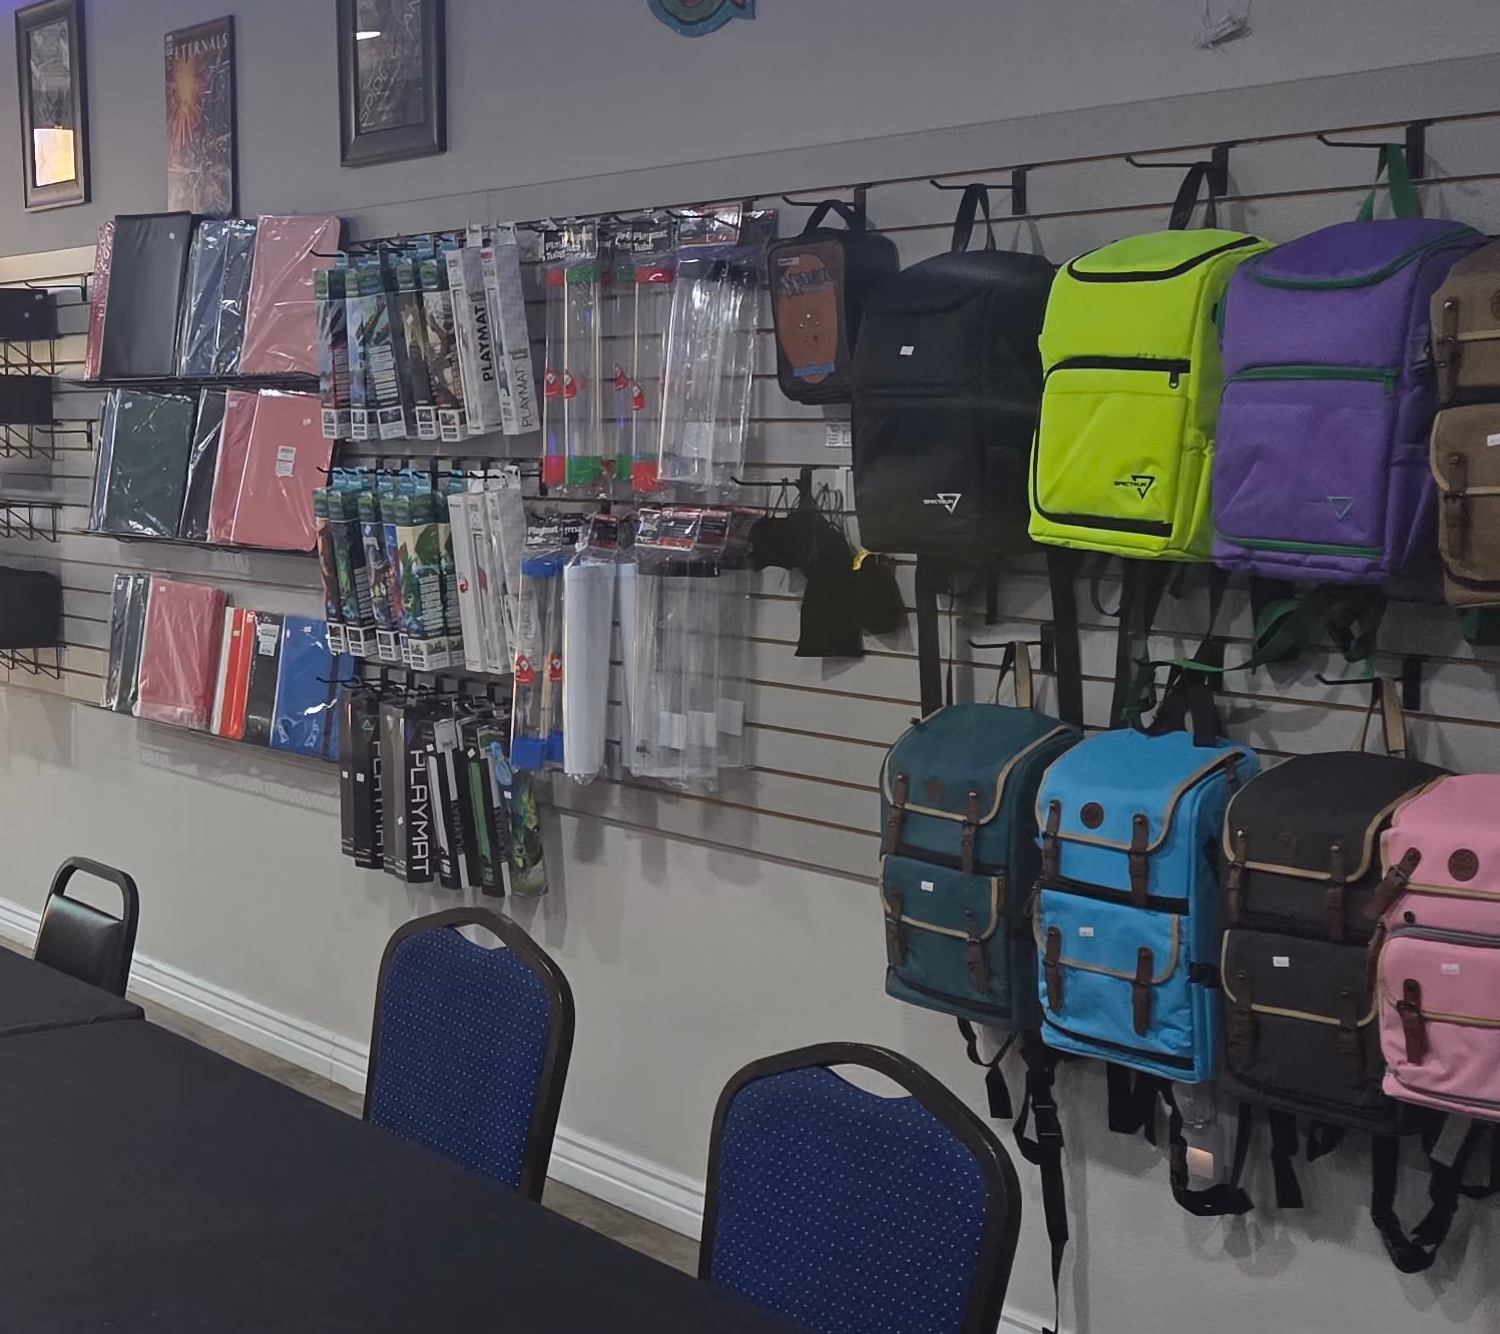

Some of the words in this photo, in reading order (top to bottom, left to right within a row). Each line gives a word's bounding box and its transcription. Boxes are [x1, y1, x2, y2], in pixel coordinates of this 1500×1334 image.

[174, 33, 228, 60] ETERNALS
[474, 305, 494, 382] PLAYMAT
[515, 369, 533, 428] PLAYMAT
[410, 749, 430, 876] PLAYMAT
